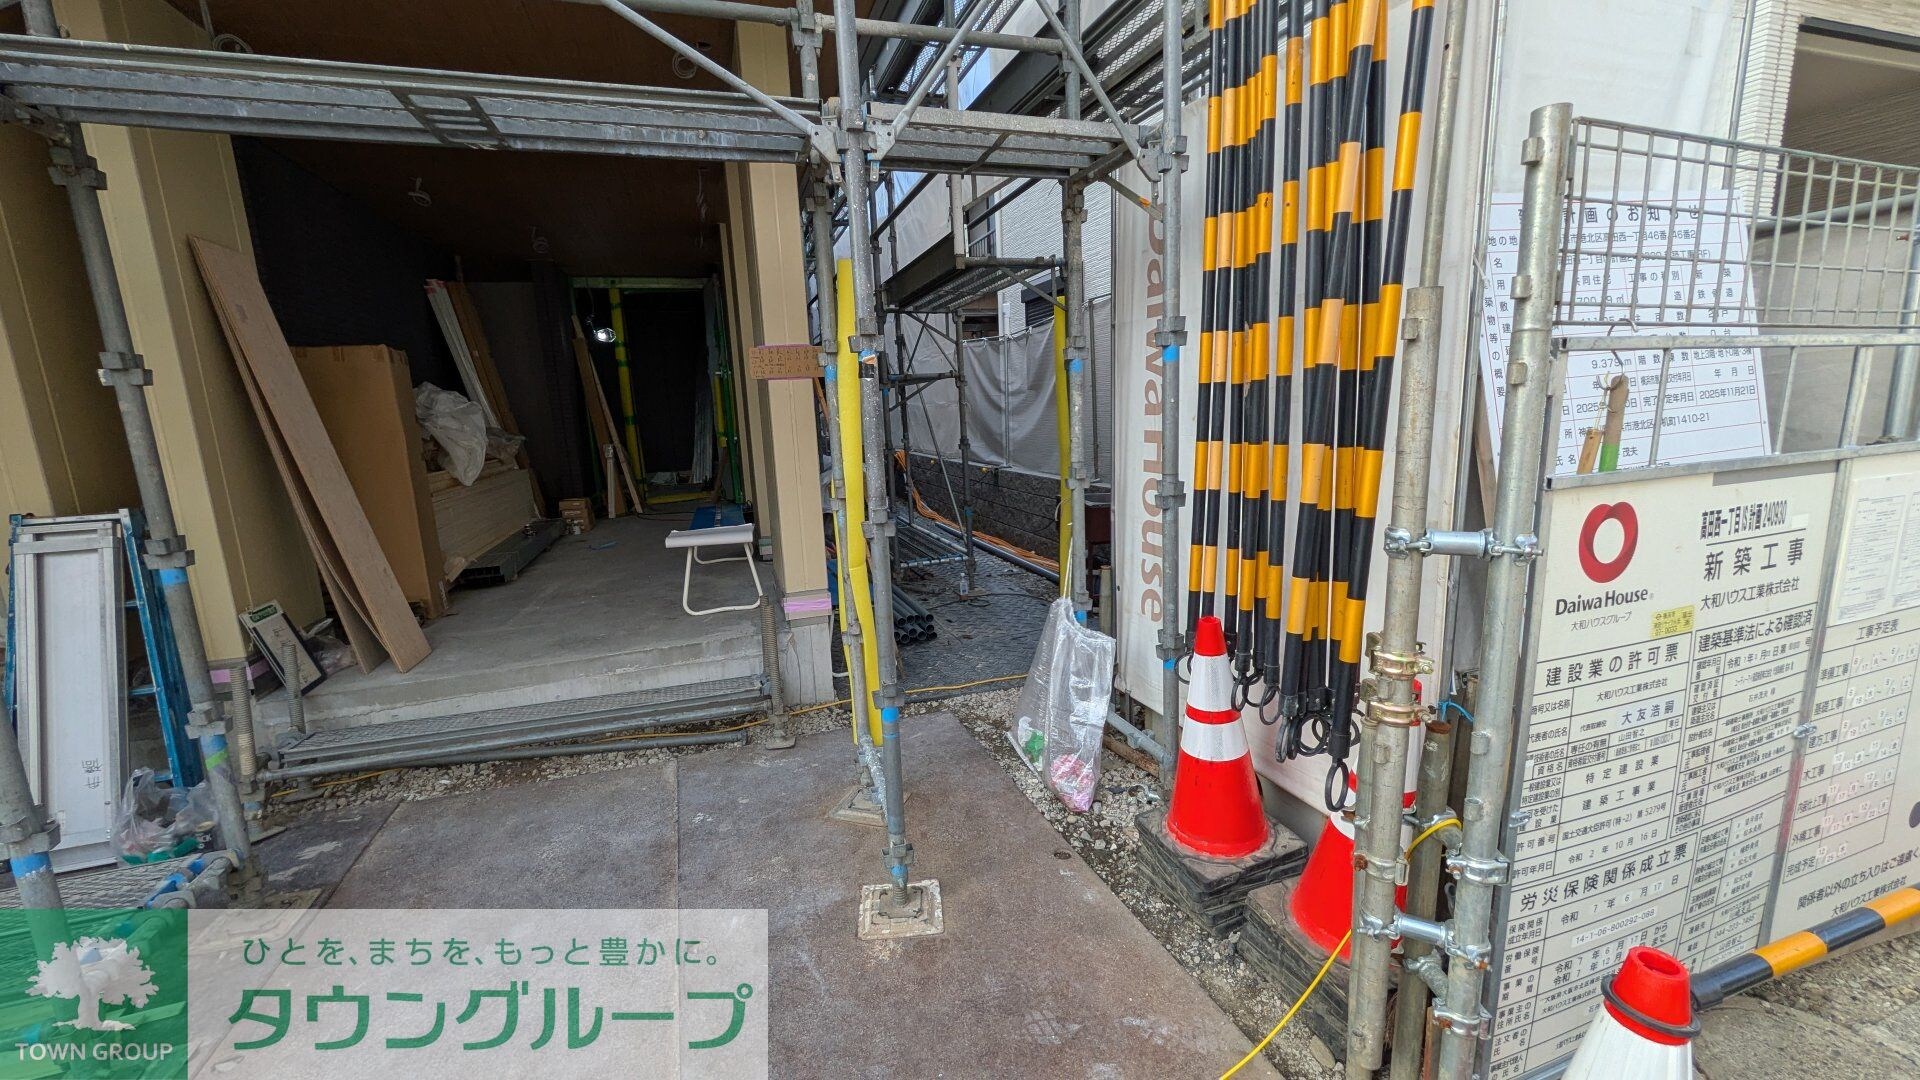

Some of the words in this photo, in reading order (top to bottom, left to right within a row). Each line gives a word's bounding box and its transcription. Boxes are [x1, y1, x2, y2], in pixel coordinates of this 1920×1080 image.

[1703, 538, 1805, 582] 新築工事
[1555, 594, 1603, 616] Daiwa
[1604, 588, 1649, 608] House
[1700, 576, 1800, 611] 大和ハウス工業株式会社
[1570, 610, 1632, 632] 大和ハウスグループ
[1698, 609, 1813, 653] 建築基準法による確認済
[1546, 641, 1680, 688] 建設業の許可票
[1597, 677, 1668, 702] 大和ハウス工業株式会社
[1520, 842, 1688, 912] 労災保険関係成立票
